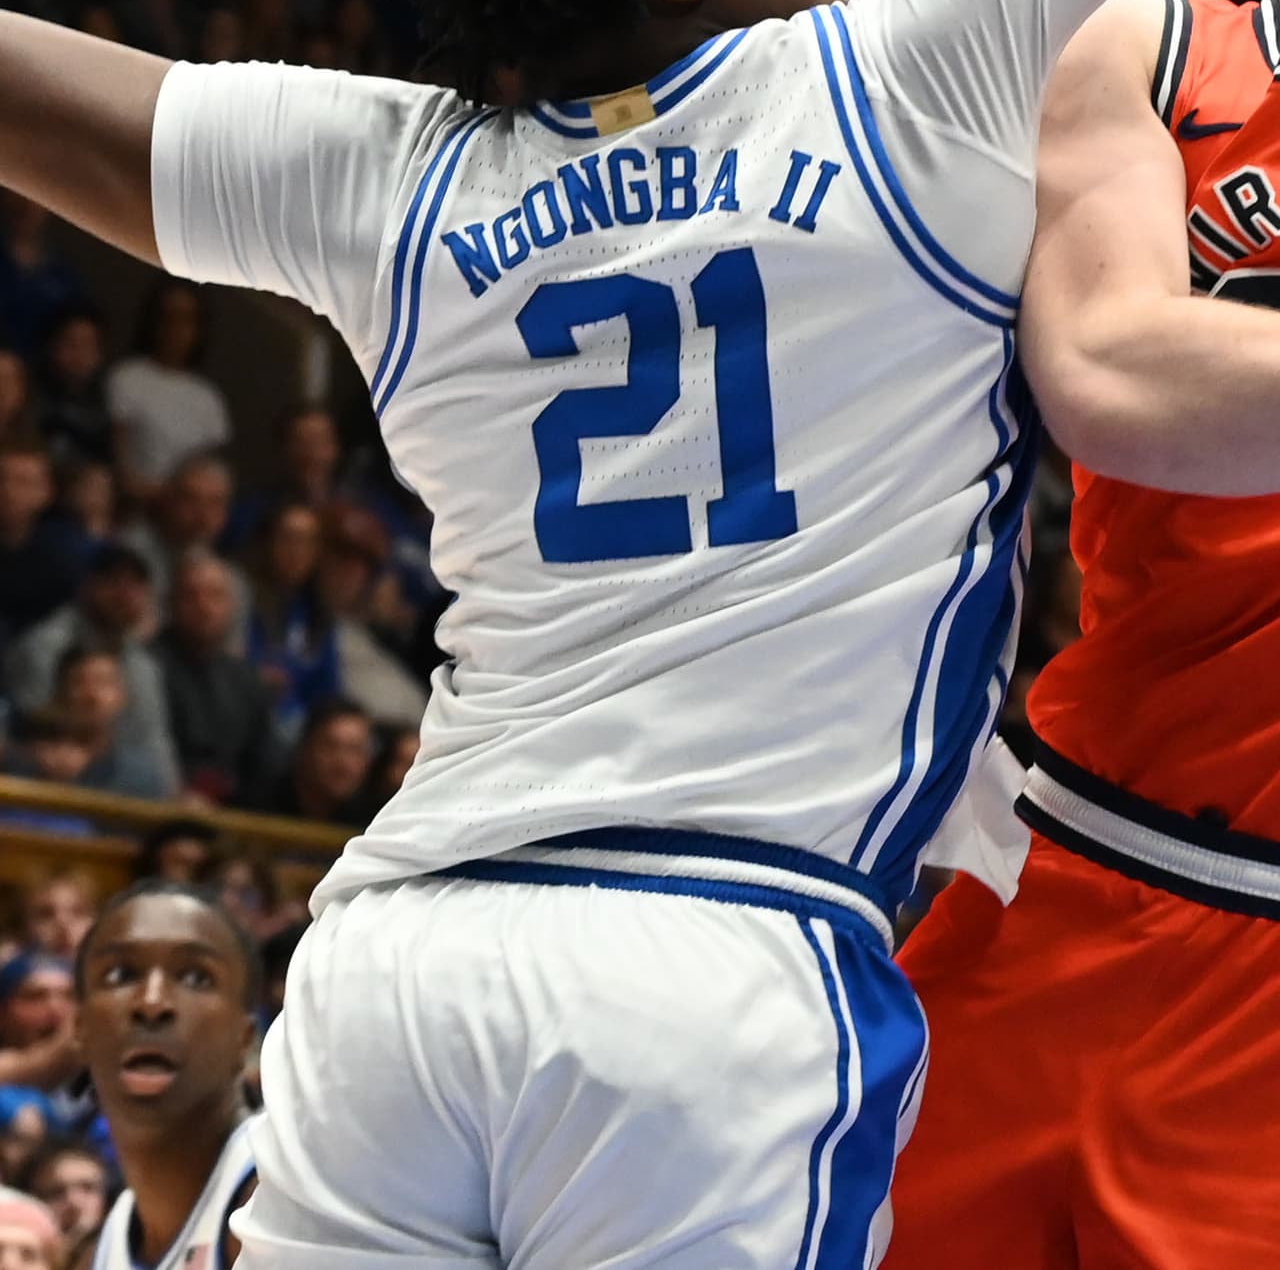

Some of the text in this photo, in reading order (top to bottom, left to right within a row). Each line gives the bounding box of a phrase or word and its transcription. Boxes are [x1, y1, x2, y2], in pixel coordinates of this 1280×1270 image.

[441, 146, 841, 298] NGONGBA II
[514, 246, 798, 564] 21
